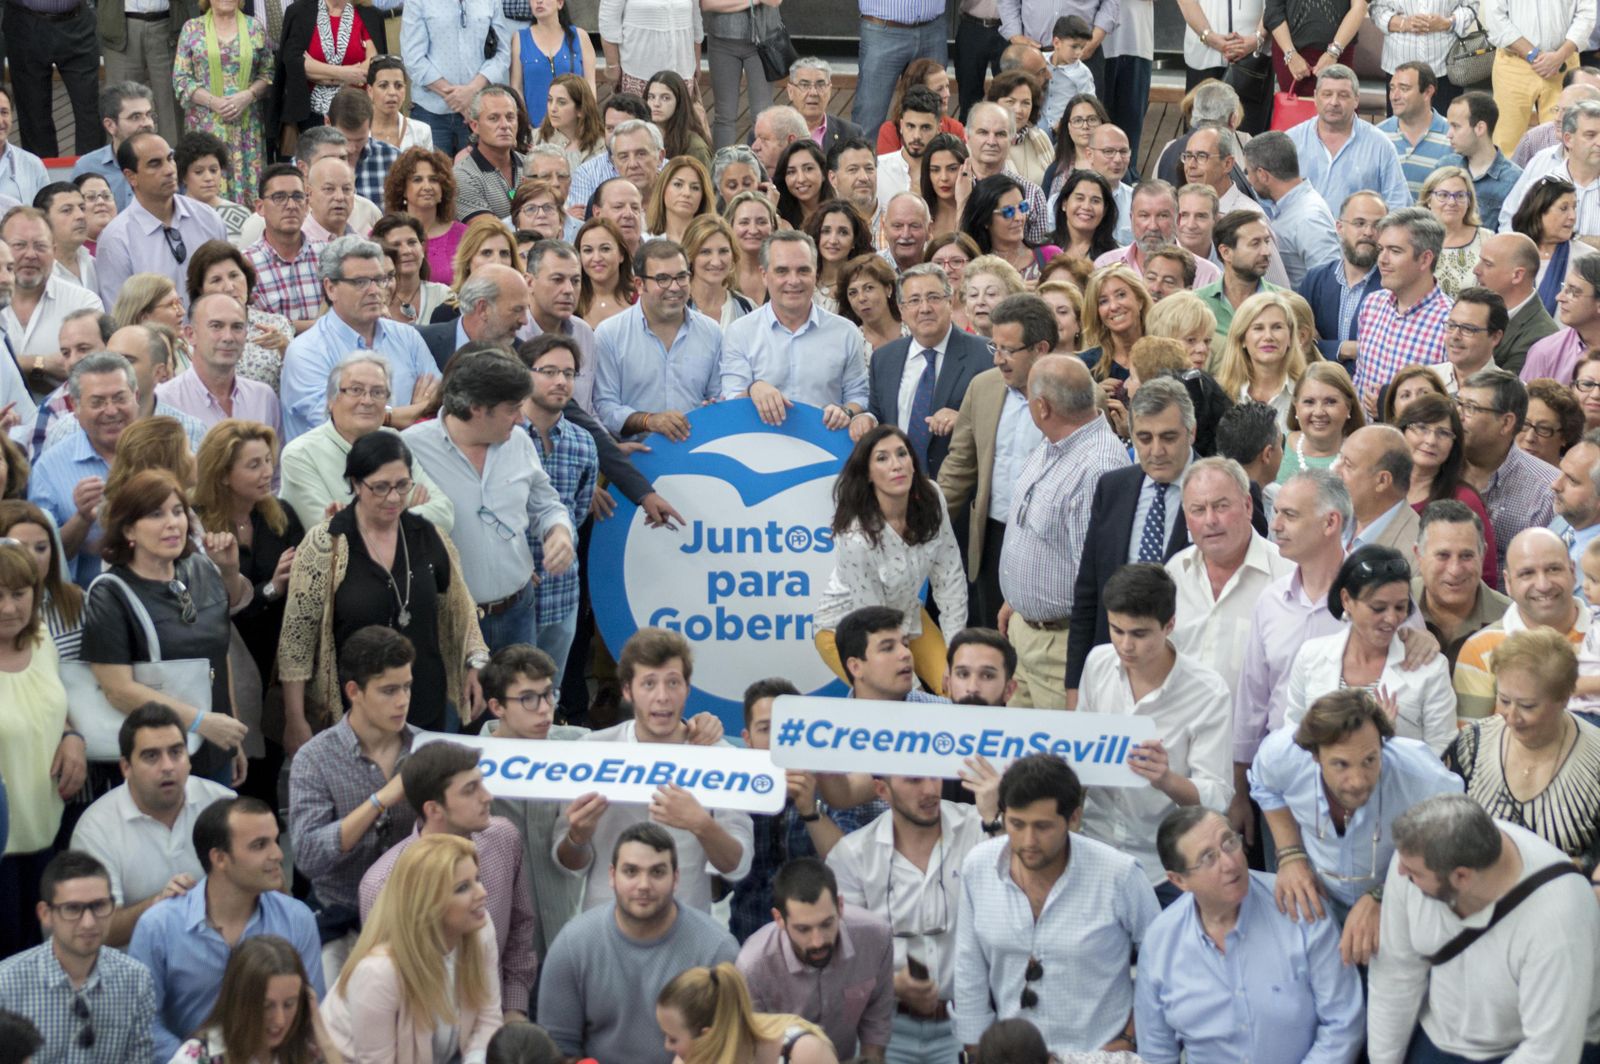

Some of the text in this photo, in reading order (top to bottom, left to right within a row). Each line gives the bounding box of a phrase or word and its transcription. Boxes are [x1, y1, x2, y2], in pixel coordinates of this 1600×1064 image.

[679, 519, 835, 554] Juntos
[708, 569, 810, 604] para
[776, 717, 1148, 765] #CreemosEnSevill
